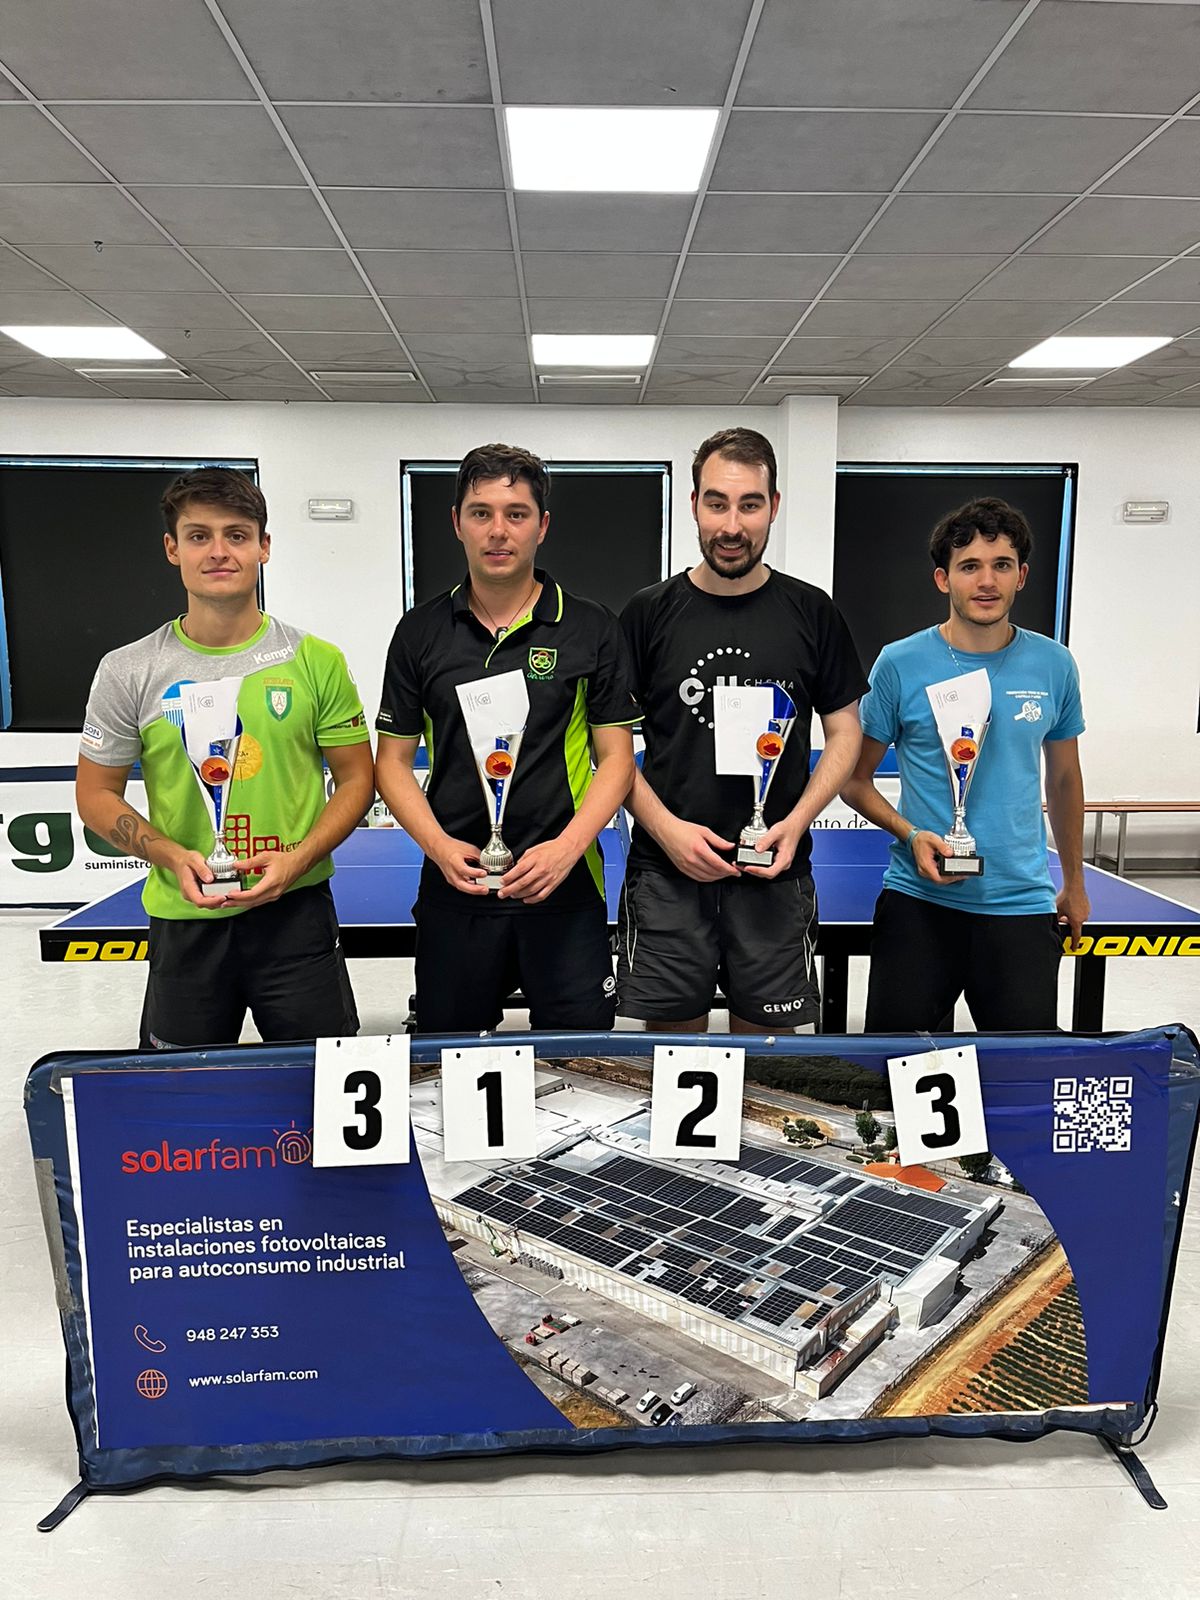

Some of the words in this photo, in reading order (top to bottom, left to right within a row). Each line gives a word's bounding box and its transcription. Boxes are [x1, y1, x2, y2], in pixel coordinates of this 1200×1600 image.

[763, 999, 802, 1013] GEWO
[342, 1069, 383, 1151] 3
[476, 1070, 504, 1148] 1
[675, 1070, 719, 1148] 2
[915, 1072, 961, 1149] 3
[121, 1138, 276, 1174] solarfam
[126, 1215, 254, 1240] Especialistas
[258, 1218, 283, 1232] en
[128, 1238, 256, 1259] instalaciones
[260, 1232, 387, 1253] fotovoltaicas
[129, 1265, 174, 1284] para
[178, 1259, 311, 1278] autoconsumo
[316, 1250, 406, 1272] industrial
[186, 1328, 216, 1342] 948
[219, 1326, 247, 1340] 247
[250, 1325, 280, 1339] 353
[188, 1369, 319, 1388] www.solarfam.com
